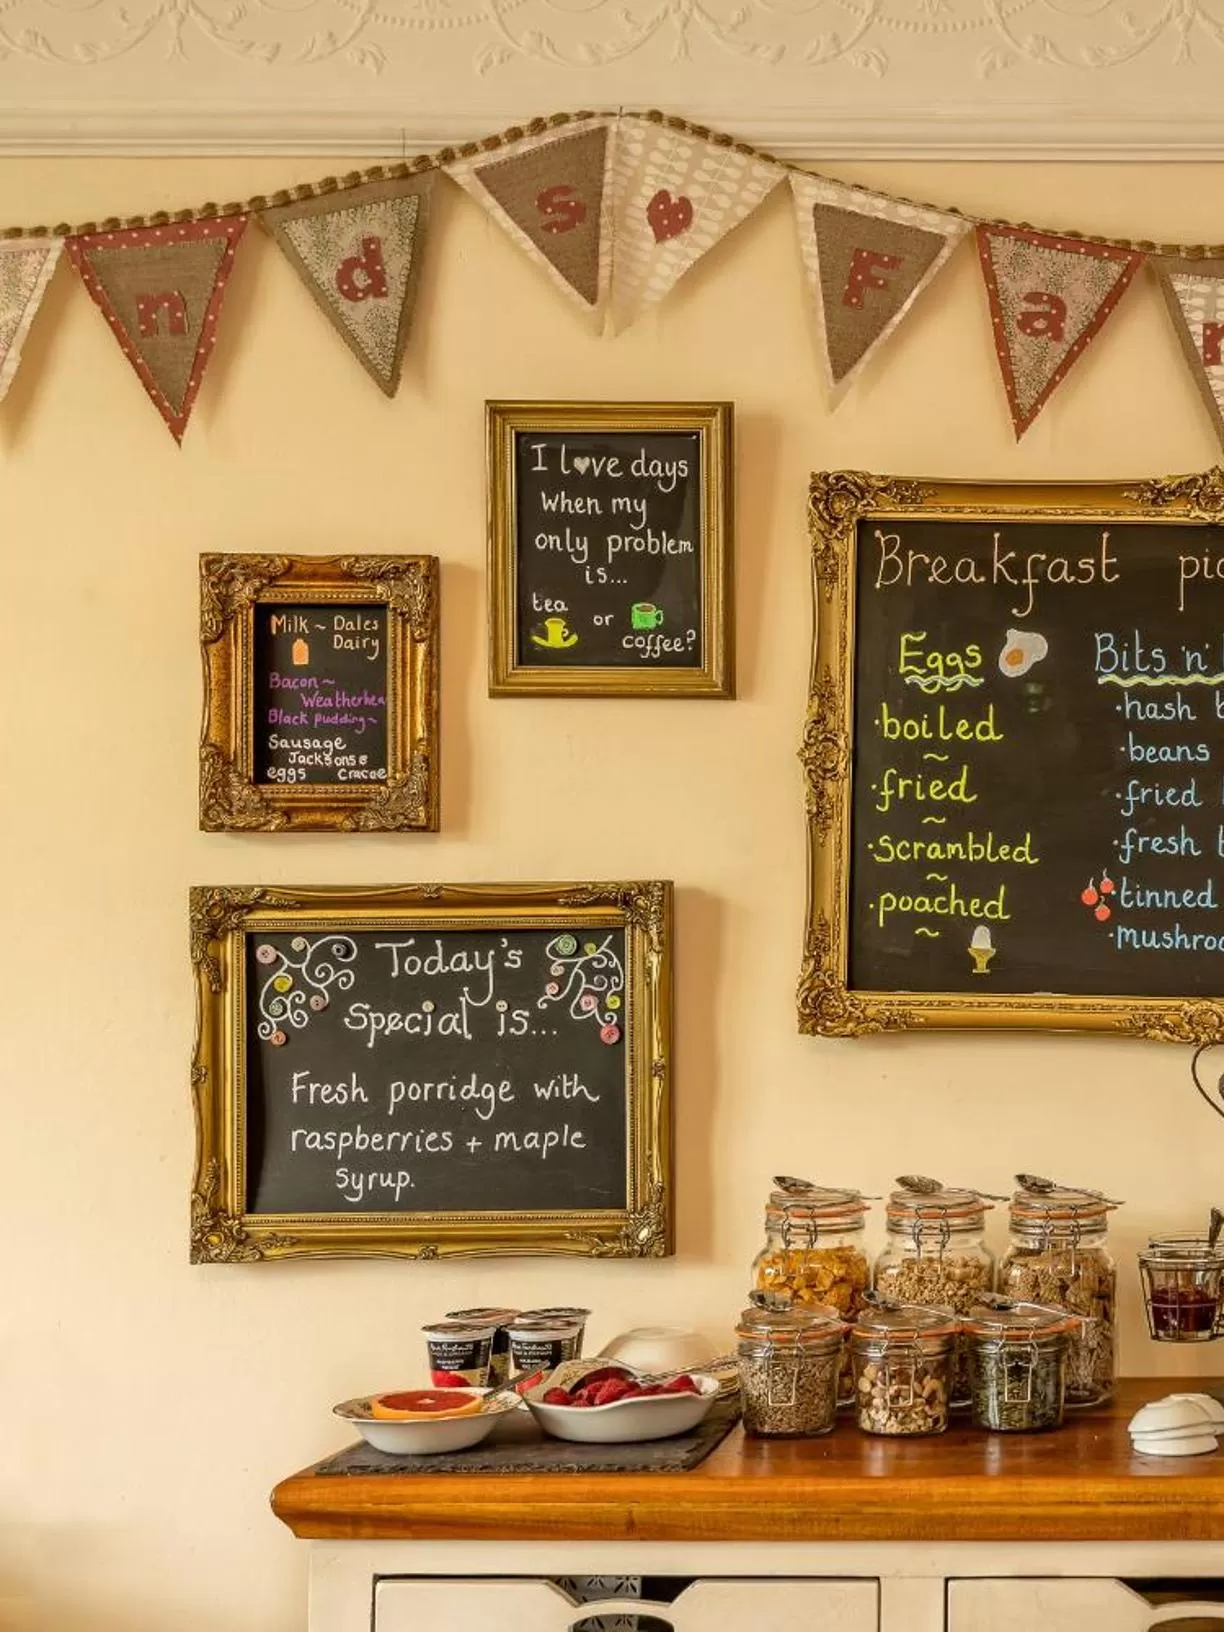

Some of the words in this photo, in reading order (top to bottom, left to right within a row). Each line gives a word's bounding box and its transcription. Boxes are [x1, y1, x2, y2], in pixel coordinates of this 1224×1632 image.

[531, 443, 548, 471] I
[631, 448, 688, 492] days
[611, 497, 646, 530] my
[535, 527, 588, 564] only
[607, 529, 693, 564] problem
[874, 529, 1120, 617] Breakfast
[532, 592, 568, 612] tea
[271, 614, 310, 635] Milk
[333, 614, 379, 632] Dales
[593, 614, 614, 626] or
[333, 634, 379, 661] Dairy
[622, 630, 696, 658] coffee?
[1094, 629, 1166, 673] Bits
[898, 631, 982, 694] Eggs
[269, 672, 319, 690] Bacon
[268, 709, 309, 726] Black
[314, 713, 366, 734] pudding
[881, 702, 1004, 741] boiled
[1124, 691, 1197, 721] hash
[268, 734, 346, 755] Sausage
[1128, 731, 1210, 763] beans
[267, 767, 306, 783] eggs
[876, 765, 978, 813] fried
[1120, 777, 1203, 816] fried
[1119, 824, 1201, 864] fresh
[879, 885, 1011, 927] poached
[1120, 876, 1218, 909] tinned
[375, 938, 523, 1006] Today's
[344, 998, 472, 1048] Special
[292, 1071, 368, 1105] Fresh
[390, 1073, 515, 1120] porridge
[534, 1073, 600, 1102] with
[291, 1125, 453, 1159] raspberries
[494, 1124, 587, 1159] maple
[335, 1166, 416, 1202] syrup.
